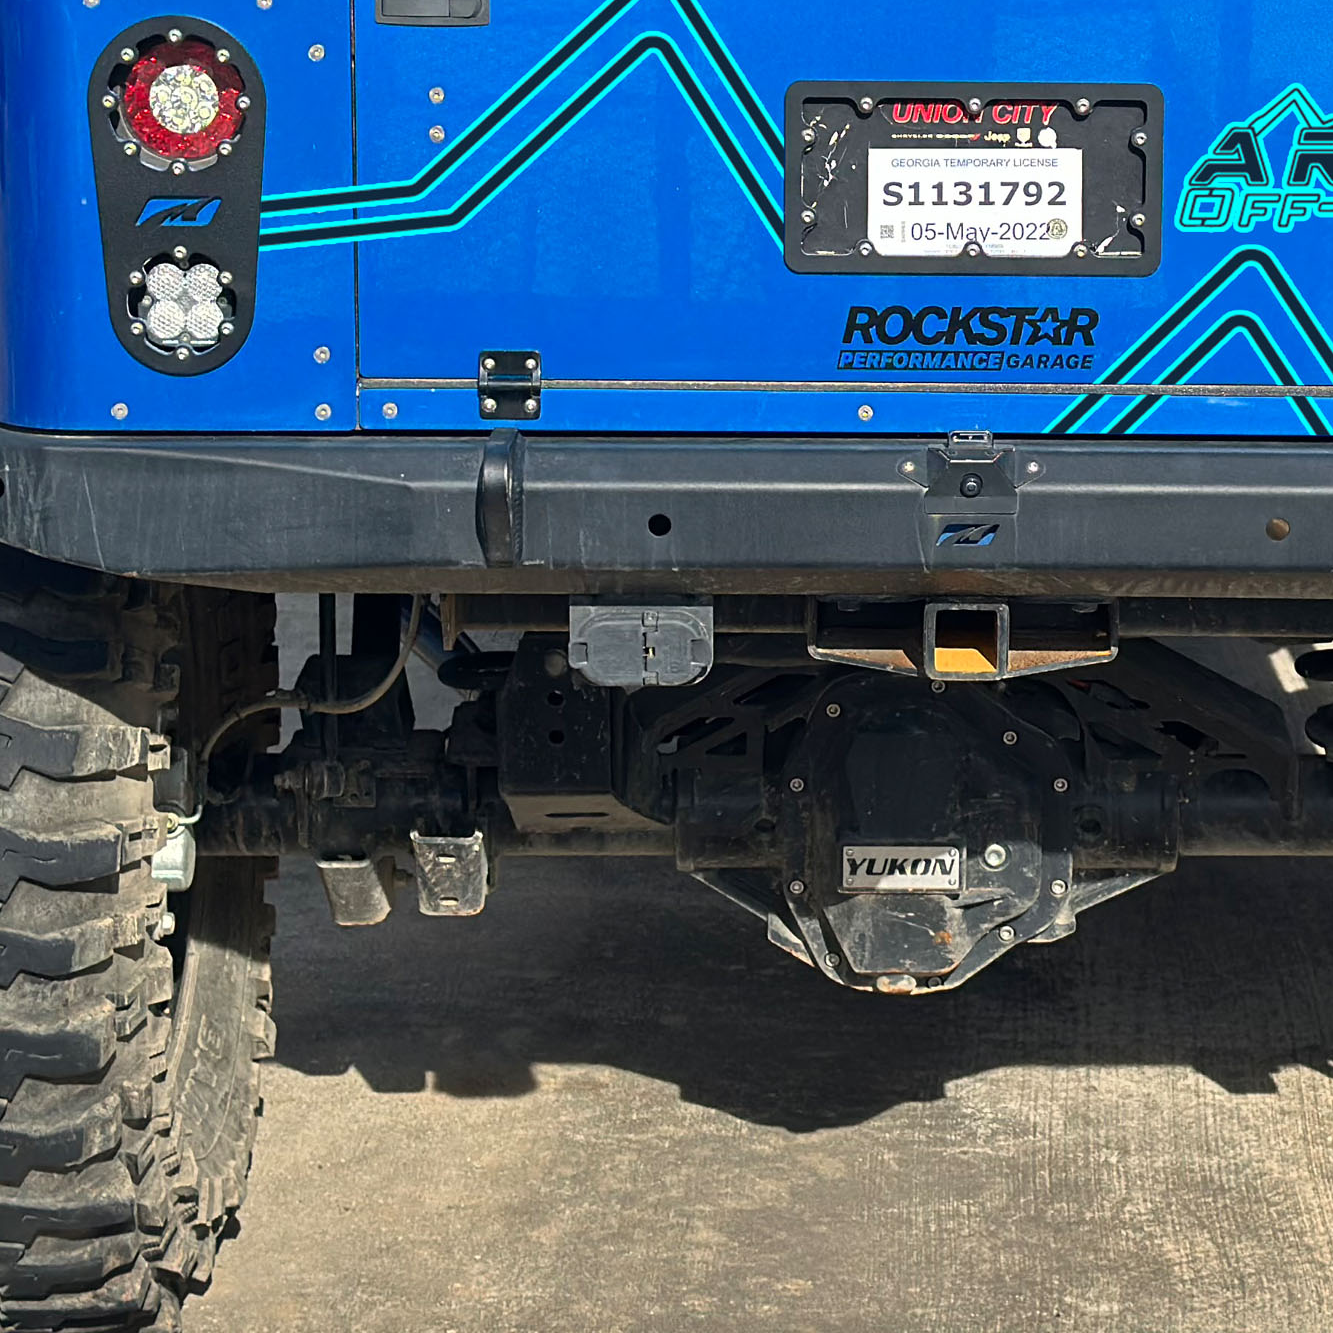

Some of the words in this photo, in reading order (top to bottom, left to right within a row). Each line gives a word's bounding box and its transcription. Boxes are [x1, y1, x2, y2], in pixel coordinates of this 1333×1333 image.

[992, 103, 1059, 126] CITY
[891, 158, 941, 168] GEORGIA
[943, 158, 1011, 168] TEMPORARY
[1013, 158, 1059, 168] LICENSE
[882, 181, 1067, 206] S1131792
[911, 222, 1050, 244] 05-May-2022
[841, 305, 1100, 347] ROCKSTAR
[839, 351, 1003, 370] PERFORMANCE
[1006, 353, 1096, 370] GARAGE
[845, 856, 957, 877] YUKON
